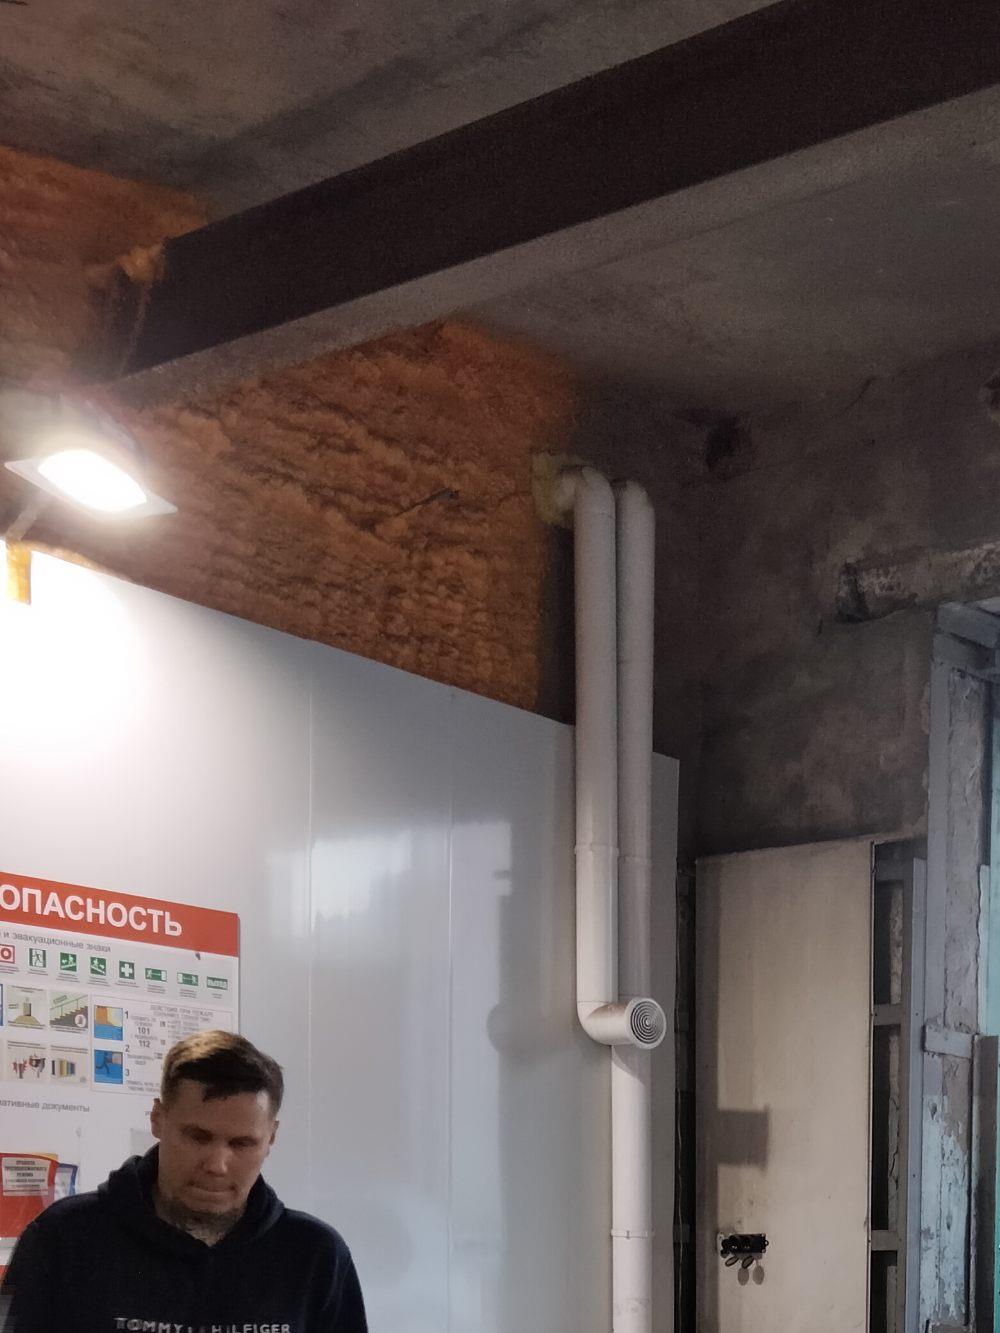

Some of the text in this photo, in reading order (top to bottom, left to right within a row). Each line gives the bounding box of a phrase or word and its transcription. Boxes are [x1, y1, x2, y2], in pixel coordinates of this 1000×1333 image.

[0, 884, 182, 937] ОПАСНОСТЬ
[12, 933, 84, 949] эвакуационные
[42, 1102, 90, 1112] документы
